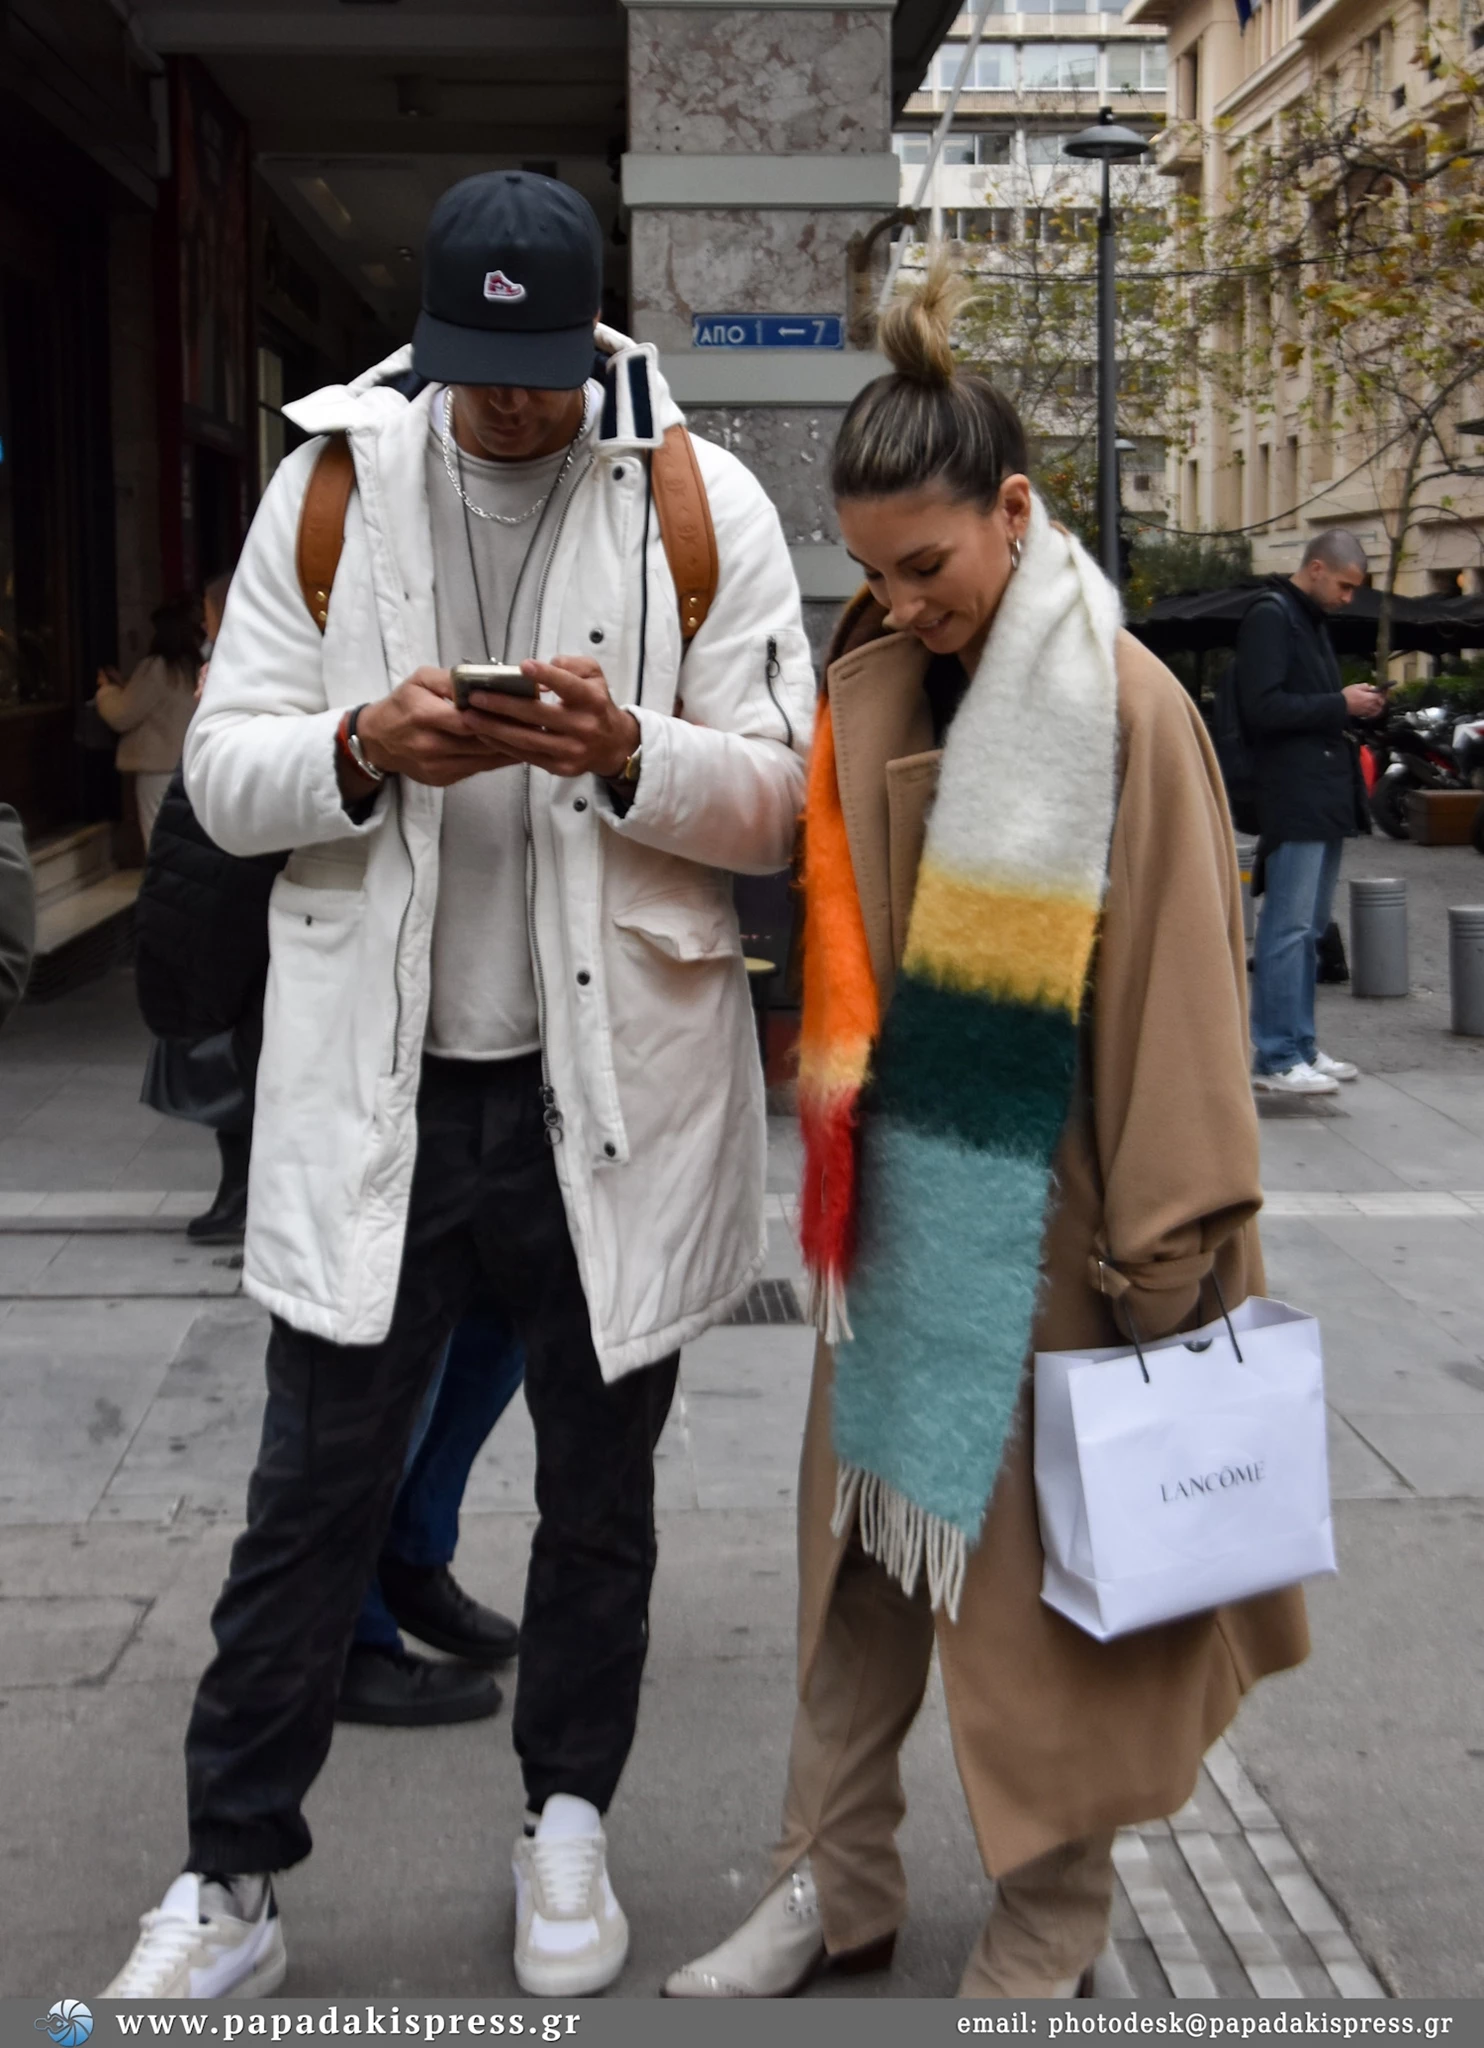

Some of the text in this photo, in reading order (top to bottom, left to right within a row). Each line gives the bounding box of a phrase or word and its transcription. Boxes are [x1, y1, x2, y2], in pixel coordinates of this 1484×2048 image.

[700, 326, 745, 343] ΑΠΟ
[812, 320, 826, 344] 7
[1160, 1461, 1265, 1502] LANCÔME
